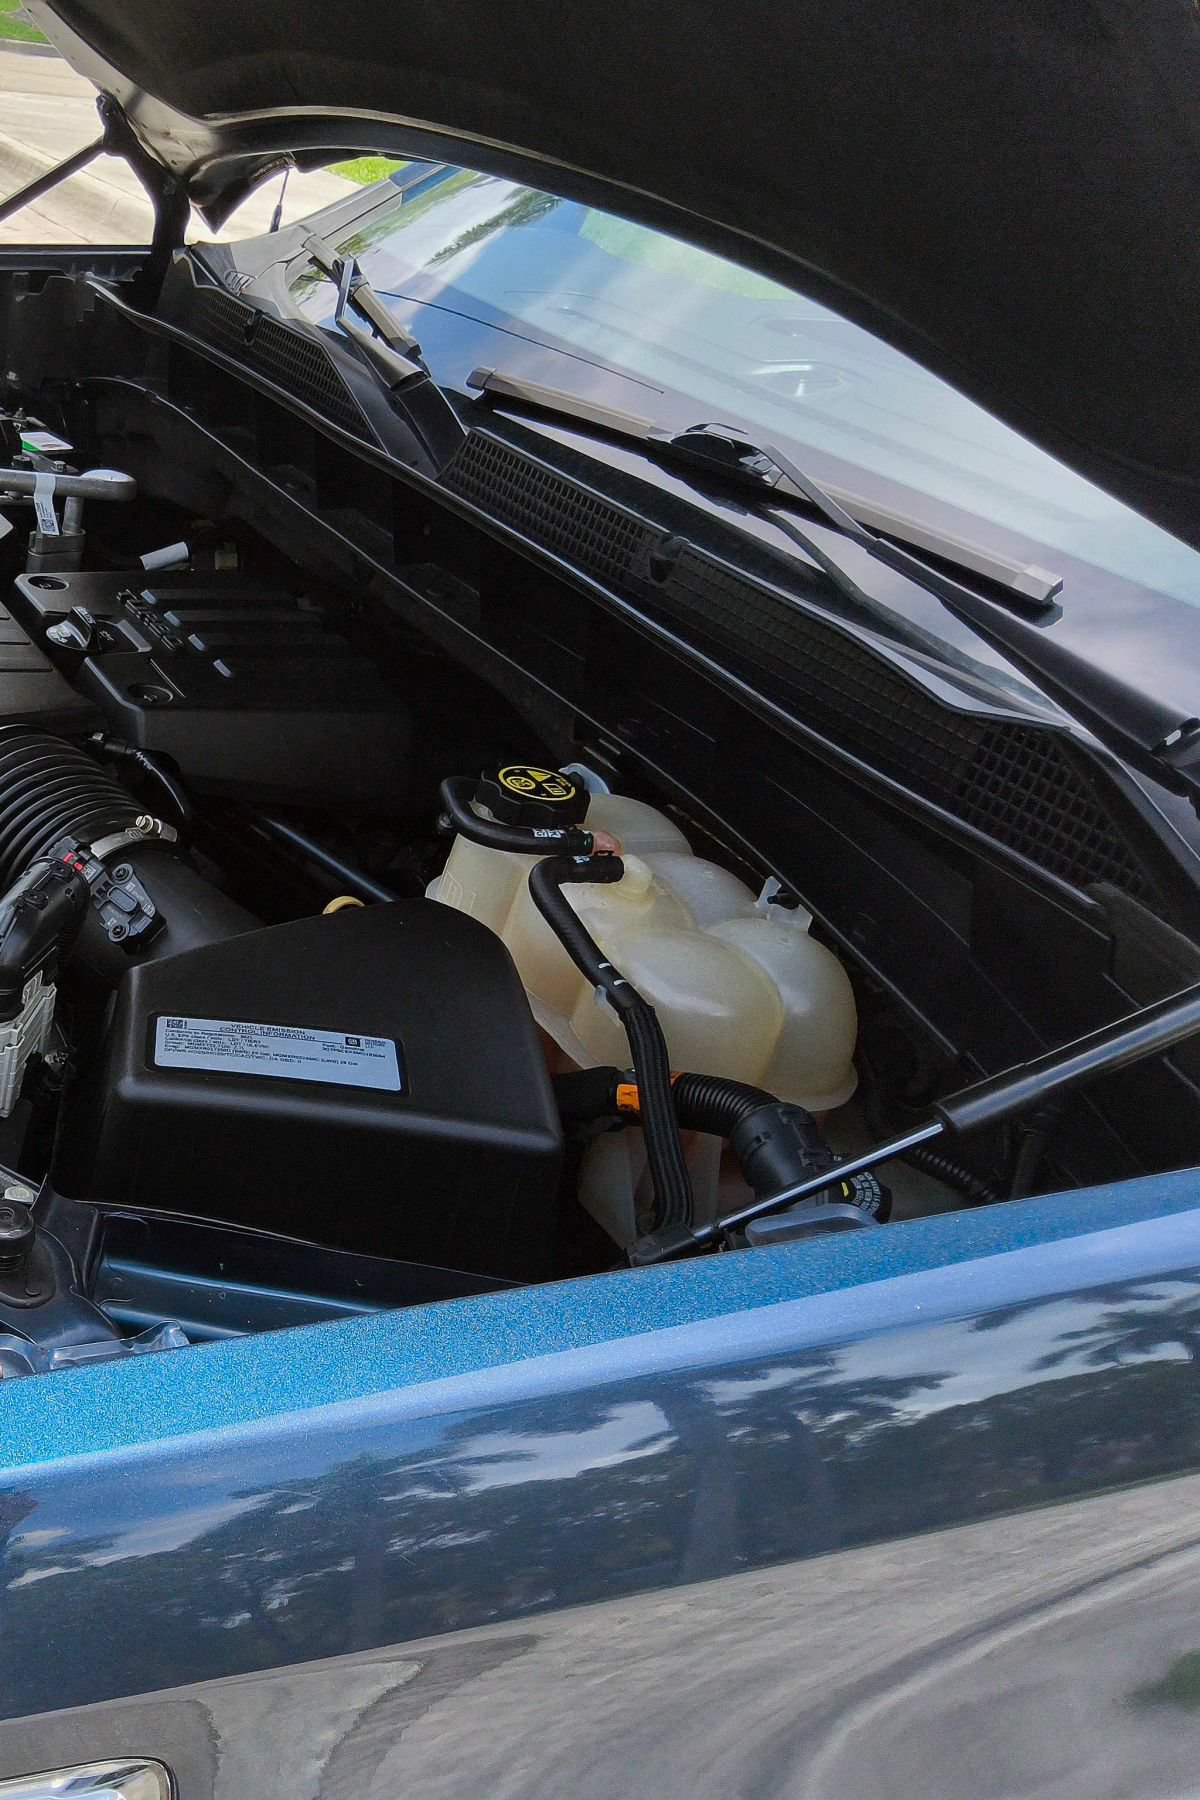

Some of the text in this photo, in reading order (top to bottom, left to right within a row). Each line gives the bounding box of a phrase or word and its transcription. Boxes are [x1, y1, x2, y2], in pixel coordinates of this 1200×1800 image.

[220, 1026, 315, 1041] CONTROL INFORMATION
[265, 1026, 305, 1035] EMISSION
